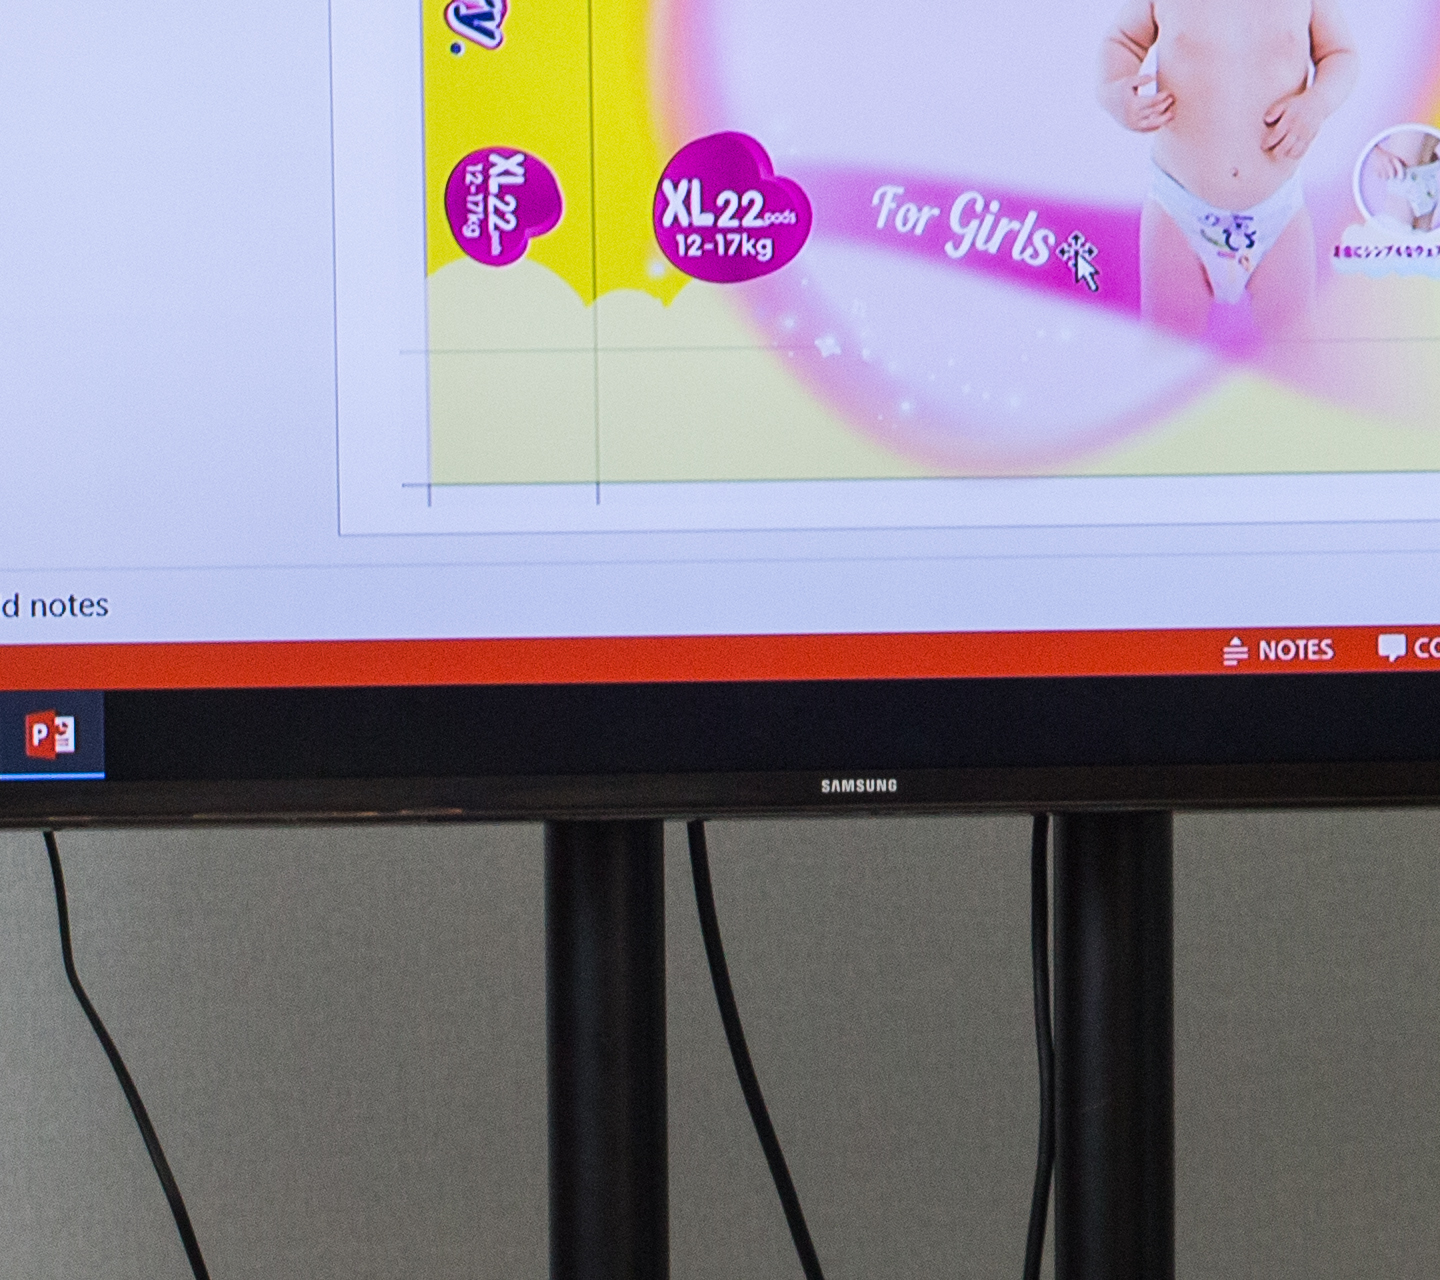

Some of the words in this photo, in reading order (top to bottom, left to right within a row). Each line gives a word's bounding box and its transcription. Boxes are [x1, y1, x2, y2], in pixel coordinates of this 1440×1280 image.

[462, 163, 485, 239] 12-17kg
[871, 183, 940, 236] For
[944, 190, 1056, 267] Girls
[675, 232, 773, 262] 12-17kg
[30, 594, 109, 618] notes
[1259, 638, 1334, 661] NOTES
[821, 778, 898, 794] SAMSUNG
